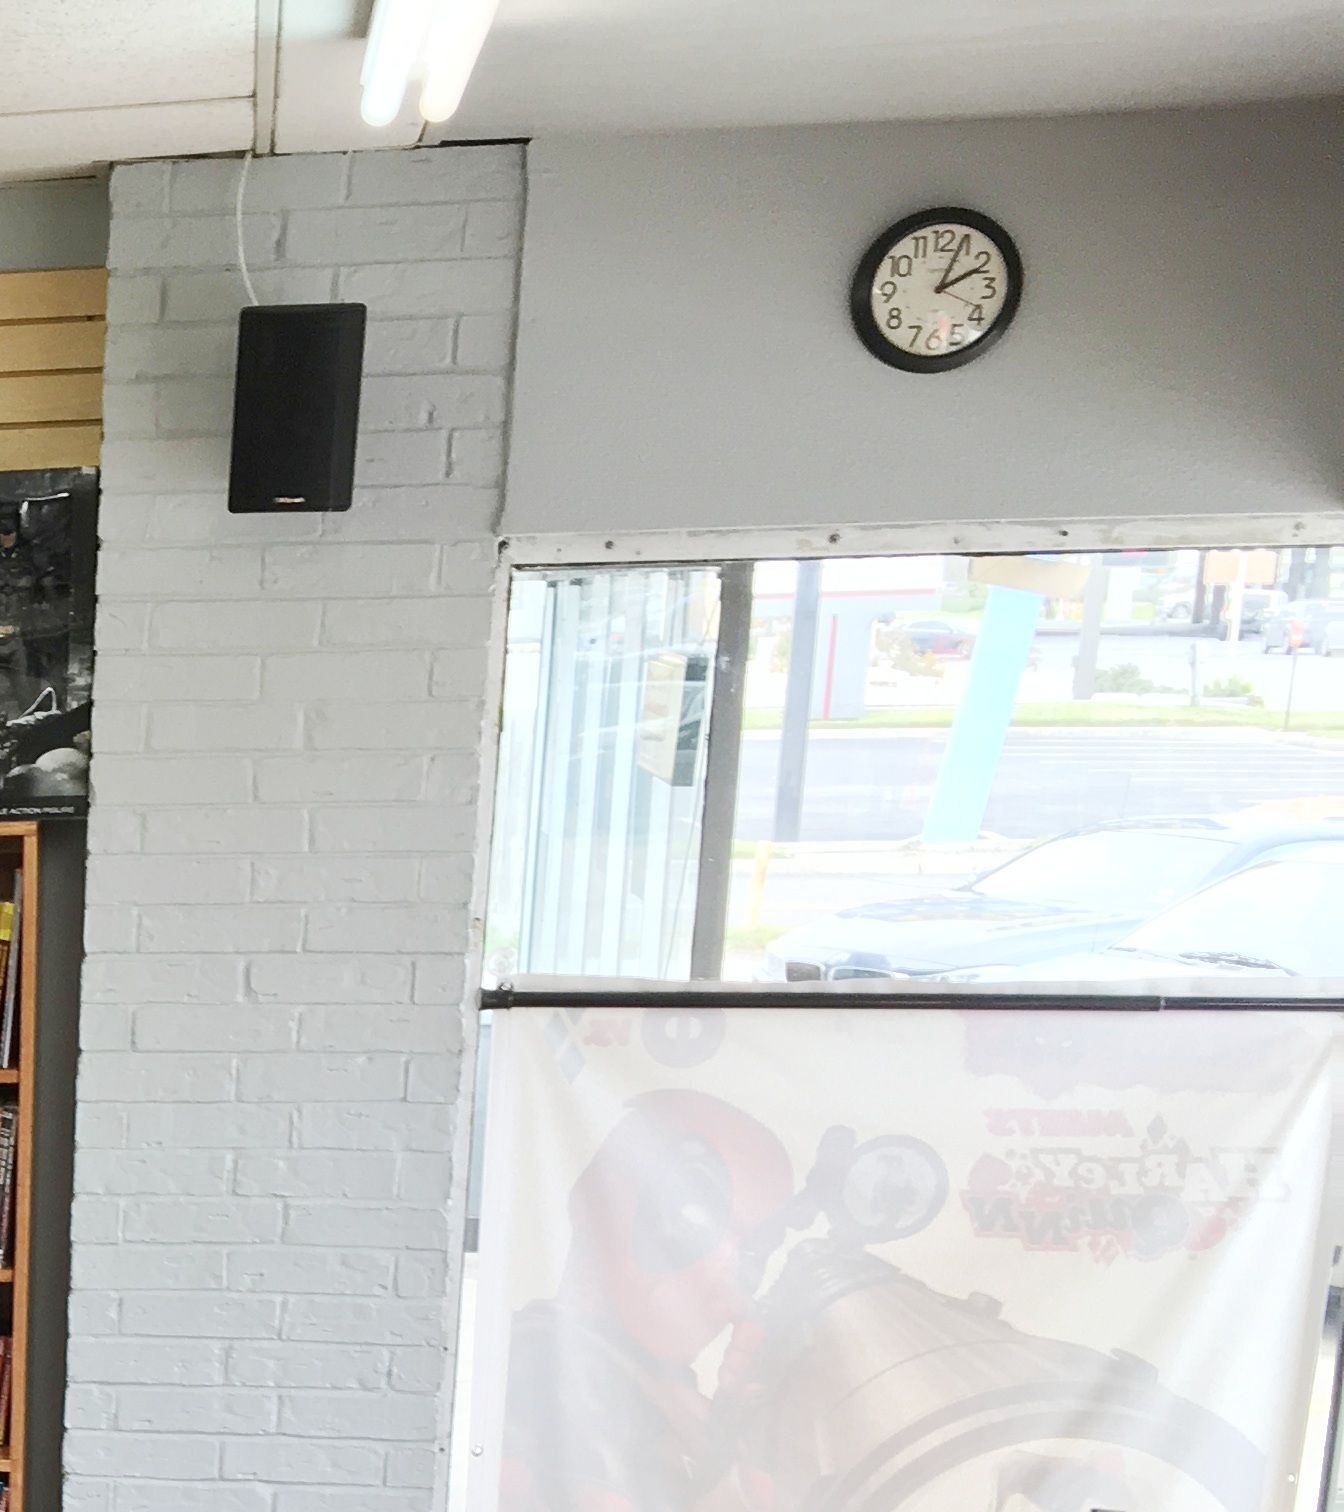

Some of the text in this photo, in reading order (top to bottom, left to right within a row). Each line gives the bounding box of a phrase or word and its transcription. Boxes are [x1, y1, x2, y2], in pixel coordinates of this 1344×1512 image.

[912, 235, 928, 259] 11
[932, 230, 957, 252] 12
[962, 234, 972, 256] 1
[887, 255, 912, 277] 10
[974, 251, 991, 274] 2
[880, 281, 897, 303] 9
[981, 277, 997, 299] 3
[886, 307, 902, 329] 8
[967, 304, 984, 326] 4
[908, 325, 923, 347] 7
[925, 327, 941, 350] 6
[949, 323, 964, 346] 5
